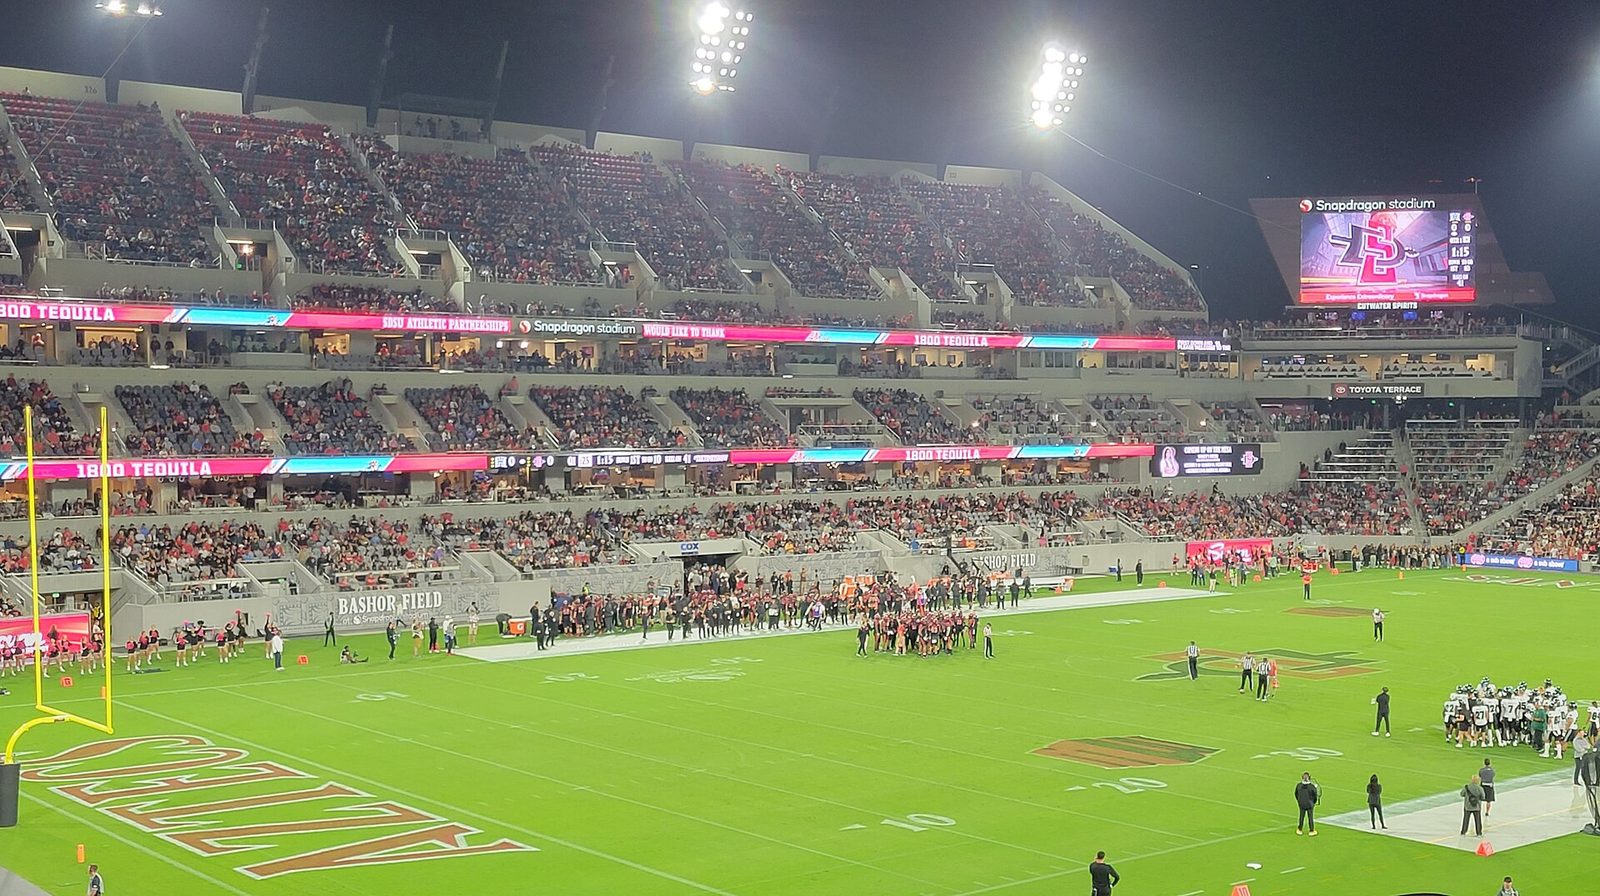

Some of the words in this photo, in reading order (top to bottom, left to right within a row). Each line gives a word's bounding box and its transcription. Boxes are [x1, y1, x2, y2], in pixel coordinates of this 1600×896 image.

[1315, 199, 1386, 212] Snapdragon
[1388, 198, 1436, 209] stadium
[37, 305, 115, 321] TEQUILA
[1357, 302, 1392, 310] CUTWATER
[382, 316, 404, 329] SDSU
[406, 317, 447, 330] ATHLETIC
[448, 319, 509, 332] PARTNERSHIPS
[534, 320, 594, 335] Snapdragon
[596, 322, 636, 334] stadium
[643, 323, 671, 337] WOULD
[672, 325, 689, 337] LIKE
[690, 326, 700, 337] TO
[701, 327, 726, 338] THANK
[914, 334, 940, 346] 1800
[942, 335, 989, 347] TEQUILA
[905, 450, 933, 461] 1800
[935, 449, 980, 461] TEQUILA
[76, 463, 125, 478] 1800
[131, 461, 212, 477] TEQUILA
[680, 542, 699, 550] COX
[1010, 553, 1036, 568] FIELD
[338, 594, 396, 615] BASHOR
[401, 591, 442, 610] FIELD
[1475, 710, 1485, 720] 27
[1091, 777, 1169, 794] 20
[879, 813, 957, 833] 10
